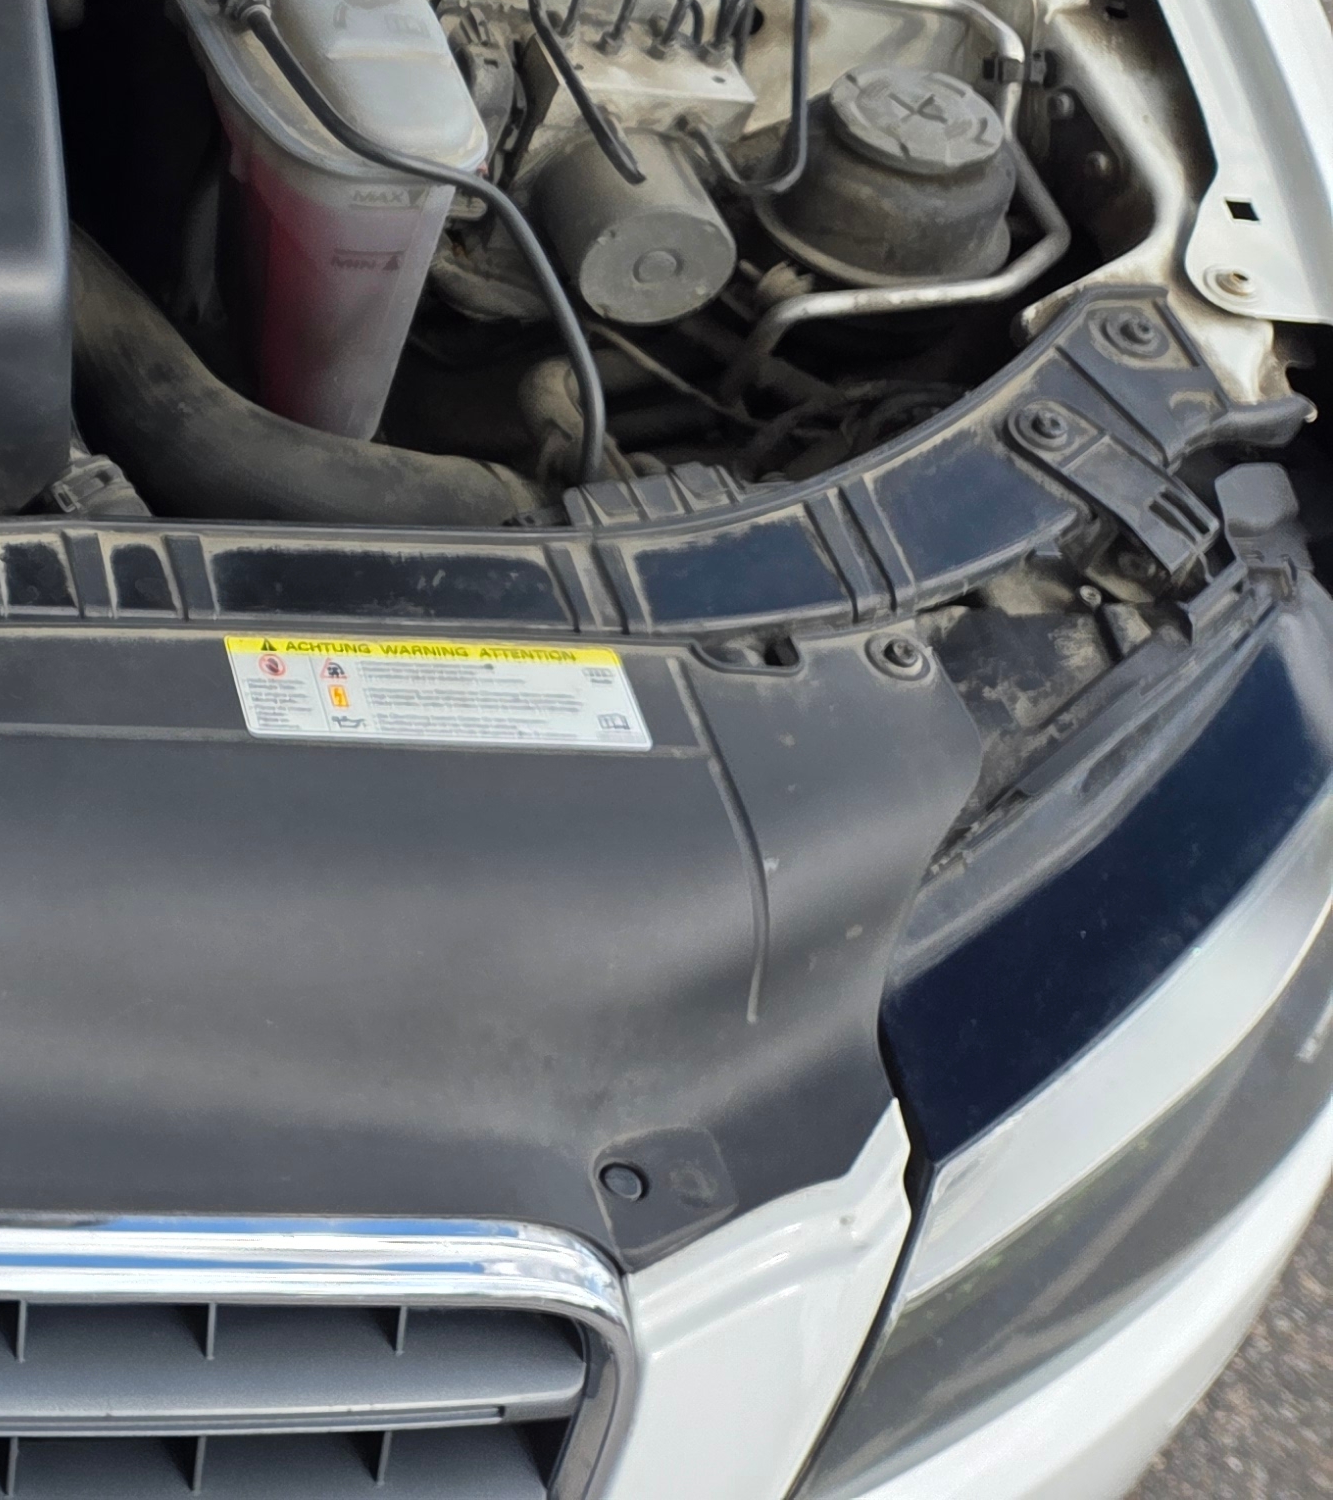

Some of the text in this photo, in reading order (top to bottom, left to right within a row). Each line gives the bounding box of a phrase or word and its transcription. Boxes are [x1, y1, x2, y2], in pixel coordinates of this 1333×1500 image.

[353, 189, 405, 204] MAX
[331, 256, 377, 270] MIN
[285, 640, 578, 663] ACHTUNG WARNING ATTENTION
